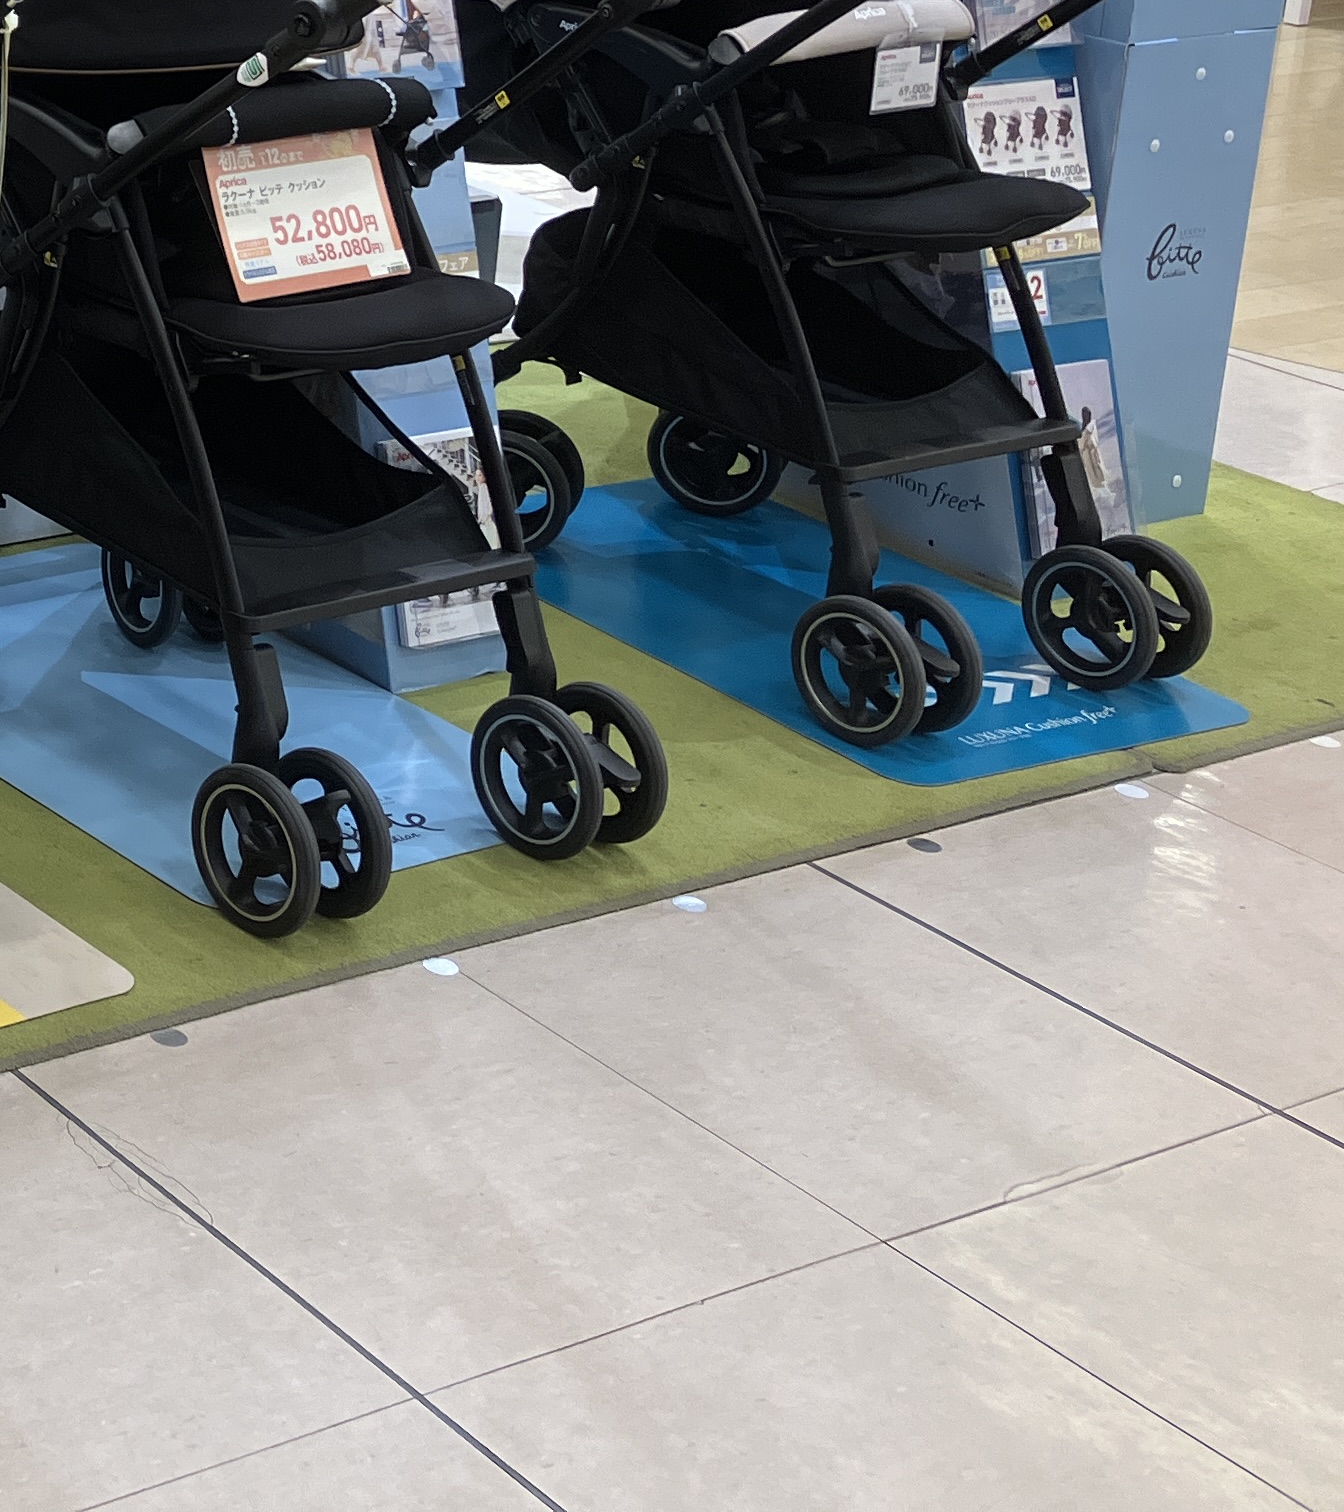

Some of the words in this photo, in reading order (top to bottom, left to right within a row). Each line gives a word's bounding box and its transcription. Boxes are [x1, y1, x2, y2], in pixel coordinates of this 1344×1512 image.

[854, 7, 887, 19] Aprica
[218, 146, 256, 171] 初売
[219, 177, 247, 189] Aprica
[221, 188, 255, 202] ラクーナ
[259, 185, 283, 197] ビッテ
[288, 178, 325, 193] クッション
[270, 204, 379, 245] 52,800円
[296, 237, 384, 266] (税込58,080円)
[958, 726, 1026, 746] LUXUNA
[1025, 714, 1085, 733] Cushion
